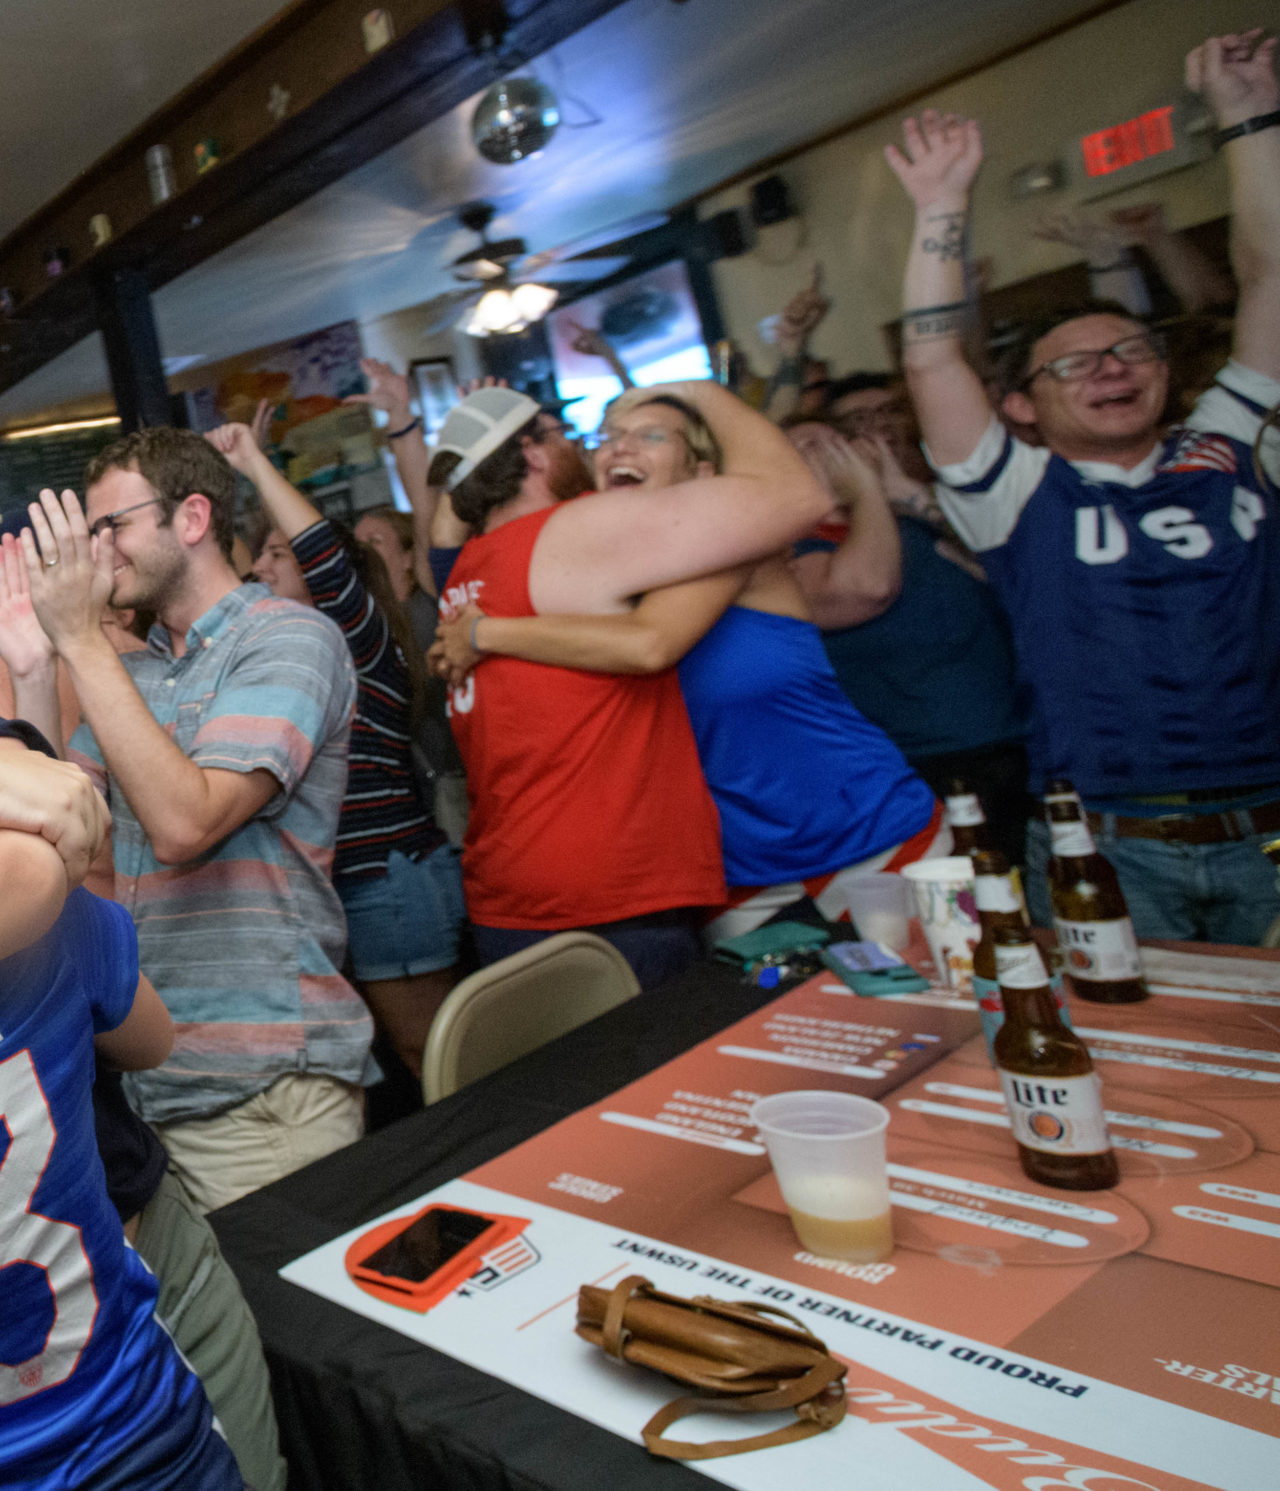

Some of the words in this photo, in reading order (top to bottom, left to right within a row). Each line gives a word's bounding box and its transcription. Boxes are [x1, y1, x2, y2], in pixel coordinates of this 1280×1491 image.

[1082, 104, 1174, 178] EXIT
[1012, 1079, 1068, 1109] Lite
[611, 1237, 699, 1272] USWNT
[699, 1266, 753, 1289] THE
[753, 1285, 795, 1305] OF
[797, 1297, 946, 1351] PARTNER
[948, 1346, 1089, 1399] PROUD
[1153, 1358, 1280, 1406] ARTER-
